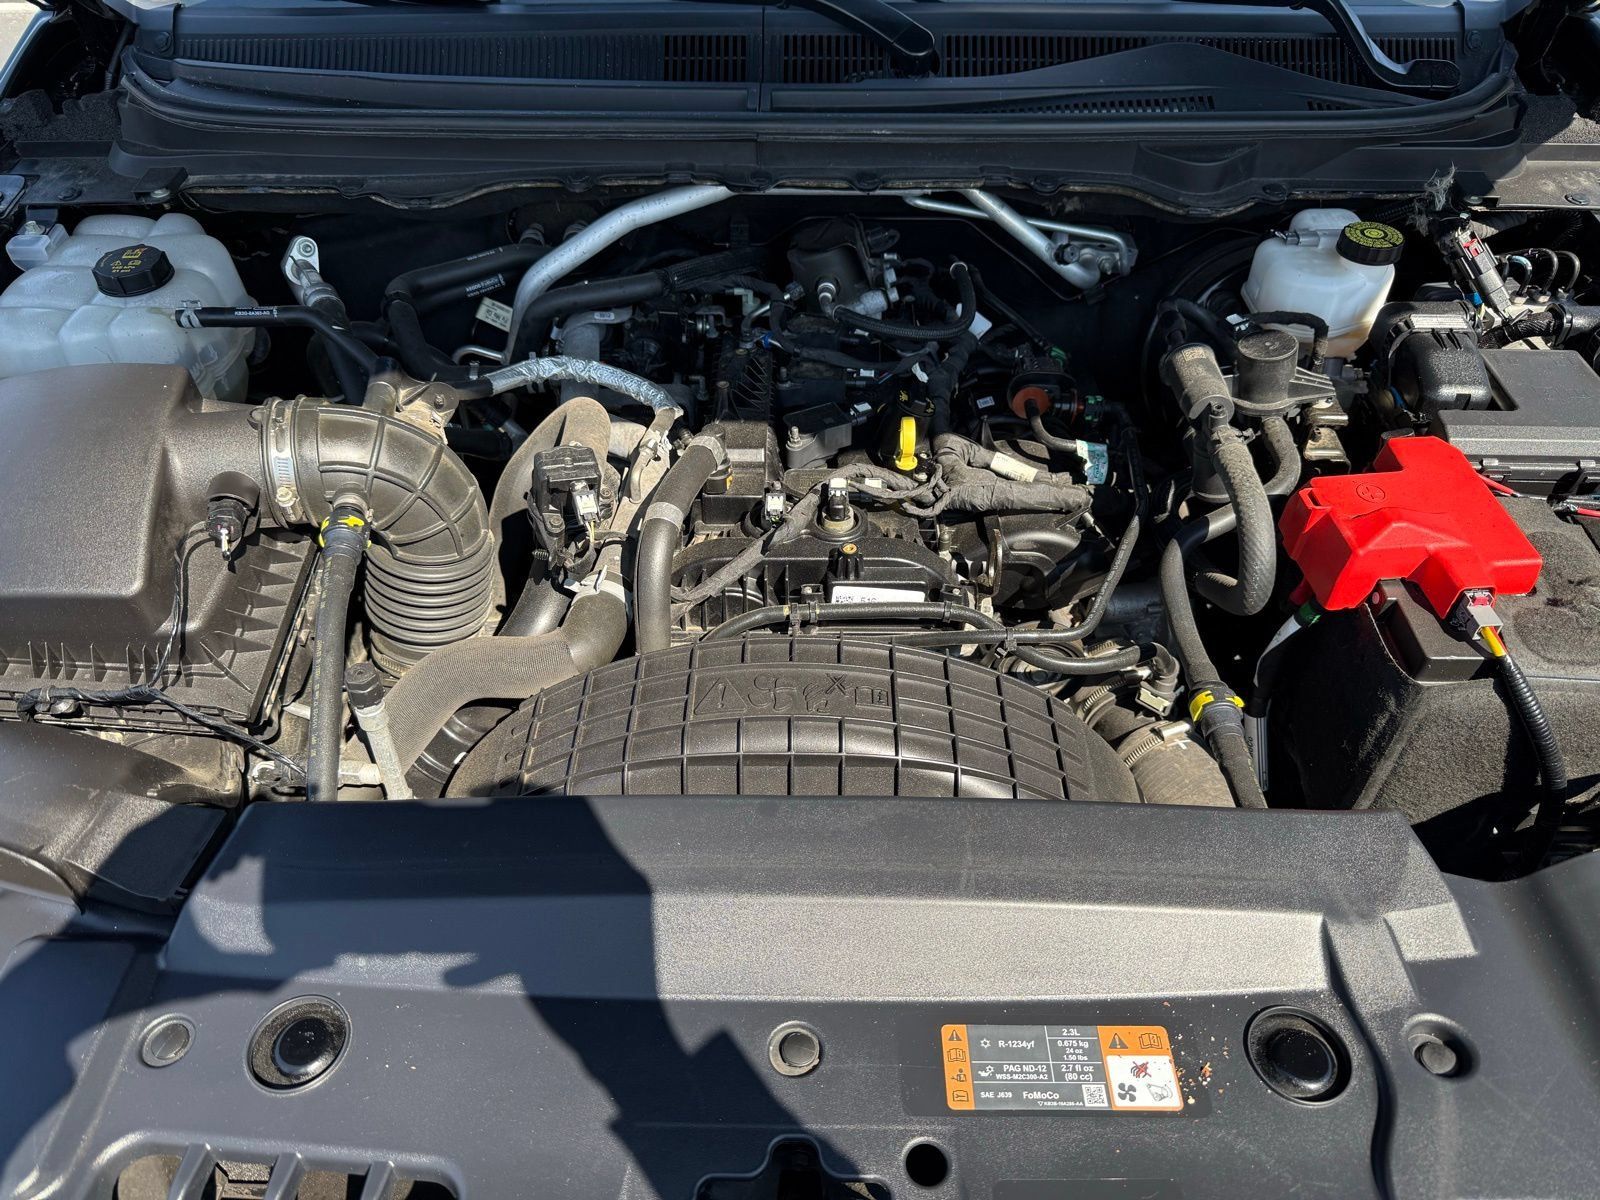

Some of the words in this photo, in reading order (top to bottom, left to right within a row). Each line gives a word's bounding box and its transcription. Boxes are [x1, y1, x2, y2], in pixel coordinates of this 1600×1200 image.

[998, 1040, 1034, 1050] R-1234yf
[1078, 1040, 1089, 1048] kg
[1065, 1073, 1078, 1081] (80
[1080, 1073, 1093, 1081] cc)
